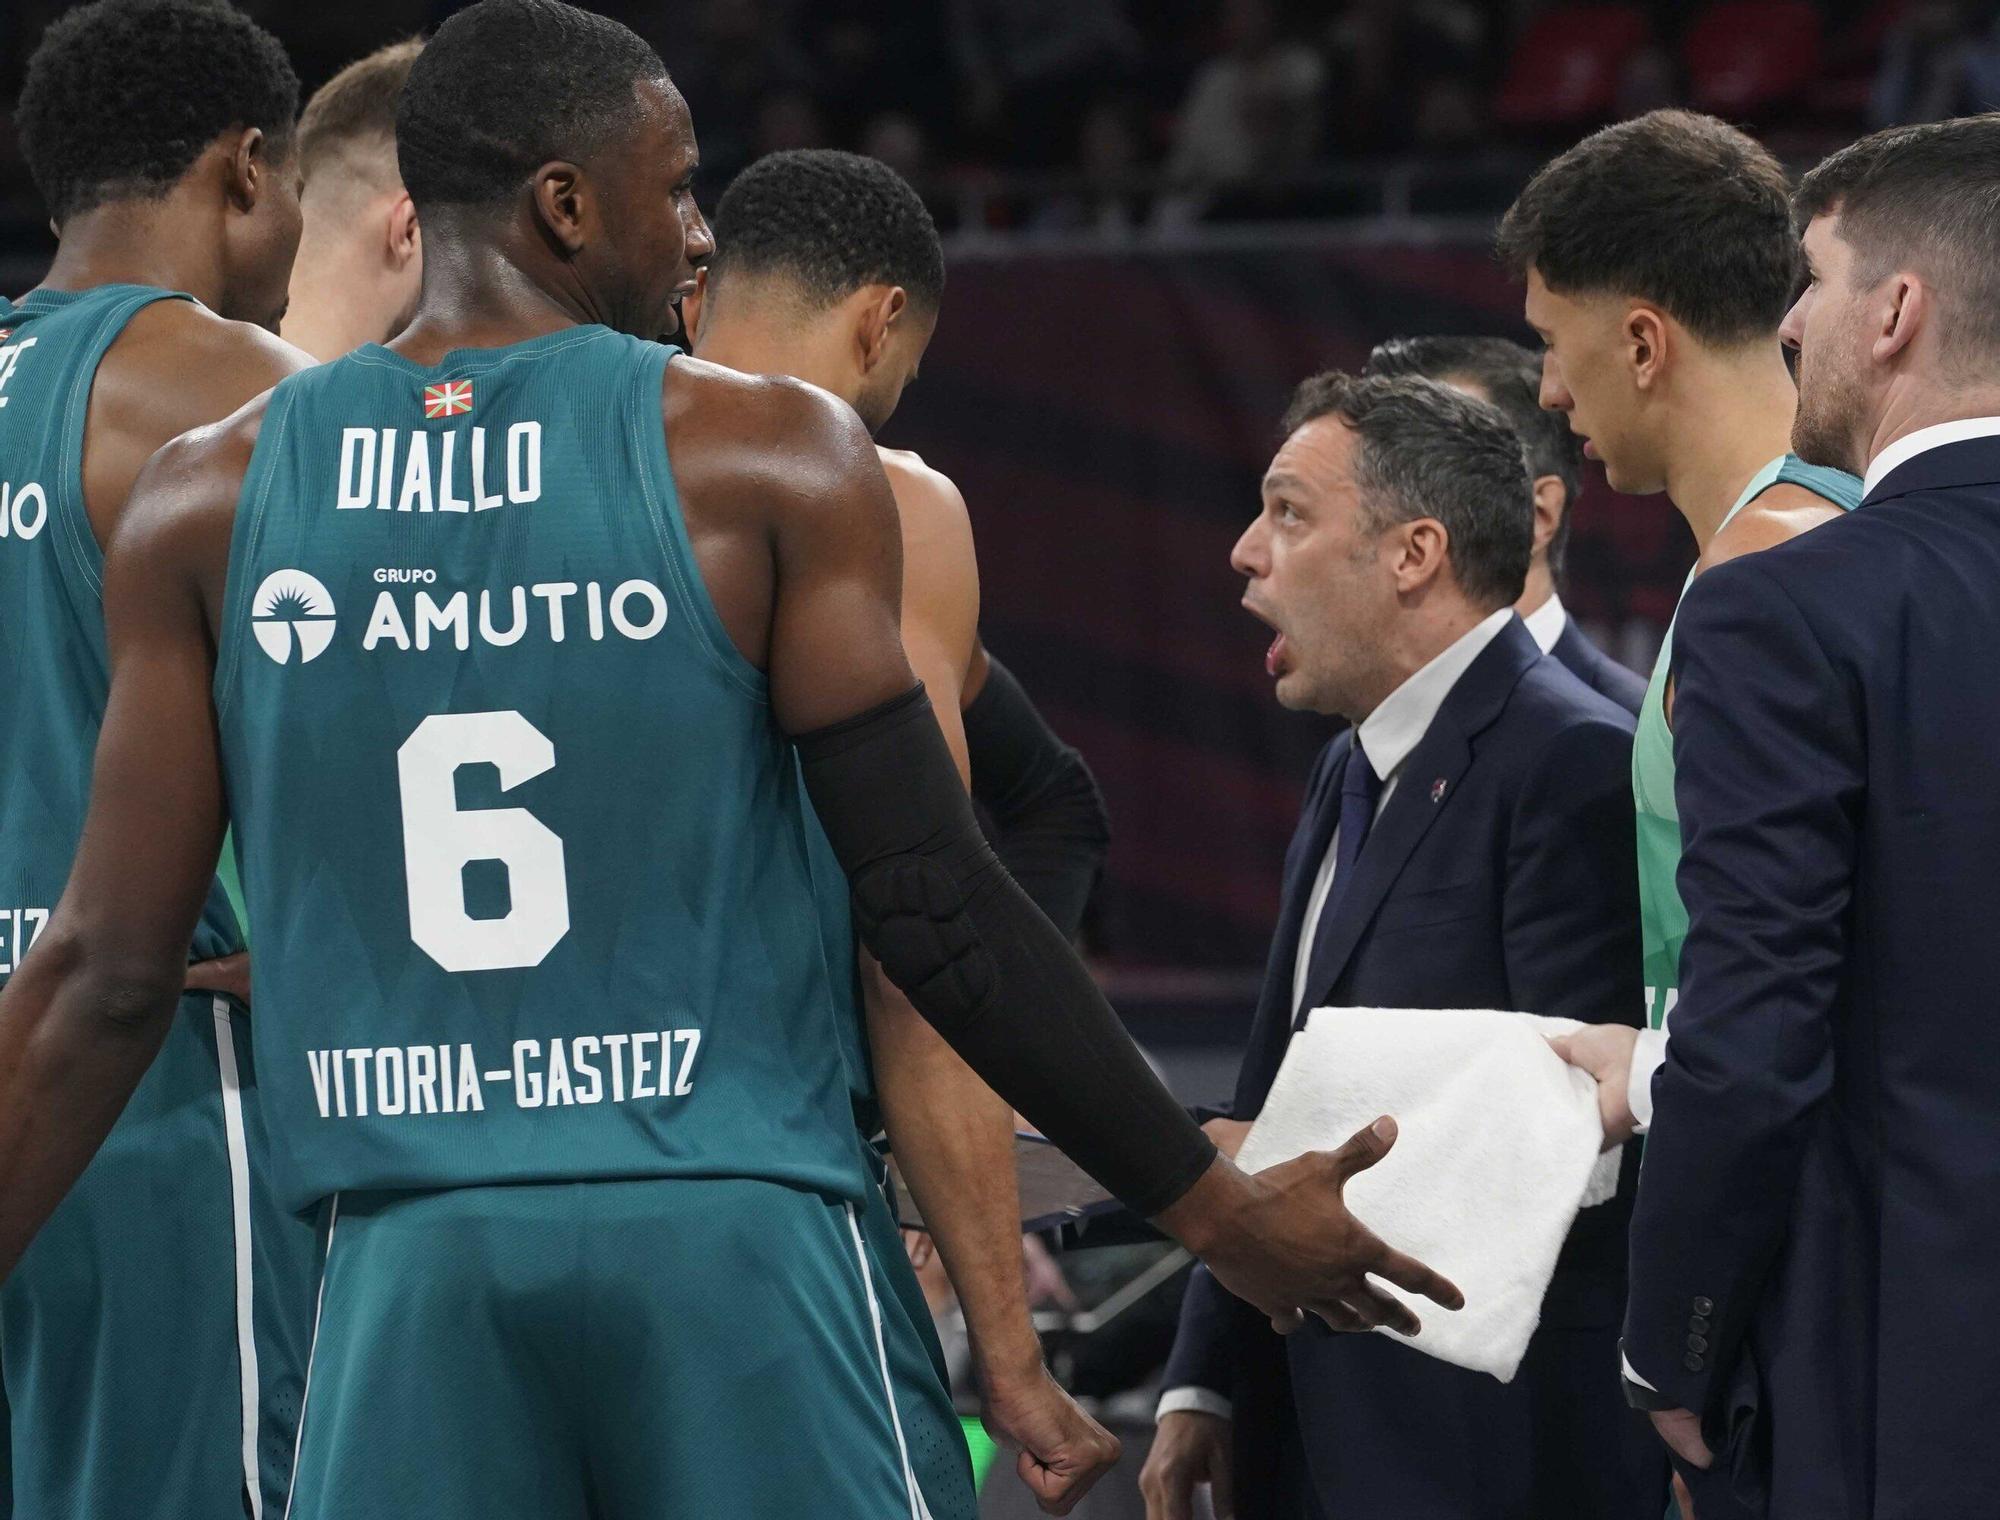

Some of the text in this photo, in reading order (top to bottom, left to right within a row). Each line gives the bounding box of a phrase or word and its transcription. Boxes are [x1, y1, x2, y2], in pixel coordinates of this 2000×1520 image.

[337, 421, 542, 513] DIALLO
[362, 578, 669, 652] AMUTIO
[373, 568, 437, 584] GRUPO
[397, 710, 571, 973] 6
[307, 1028, 702, 1118] VITORIA-GASTEIZ
